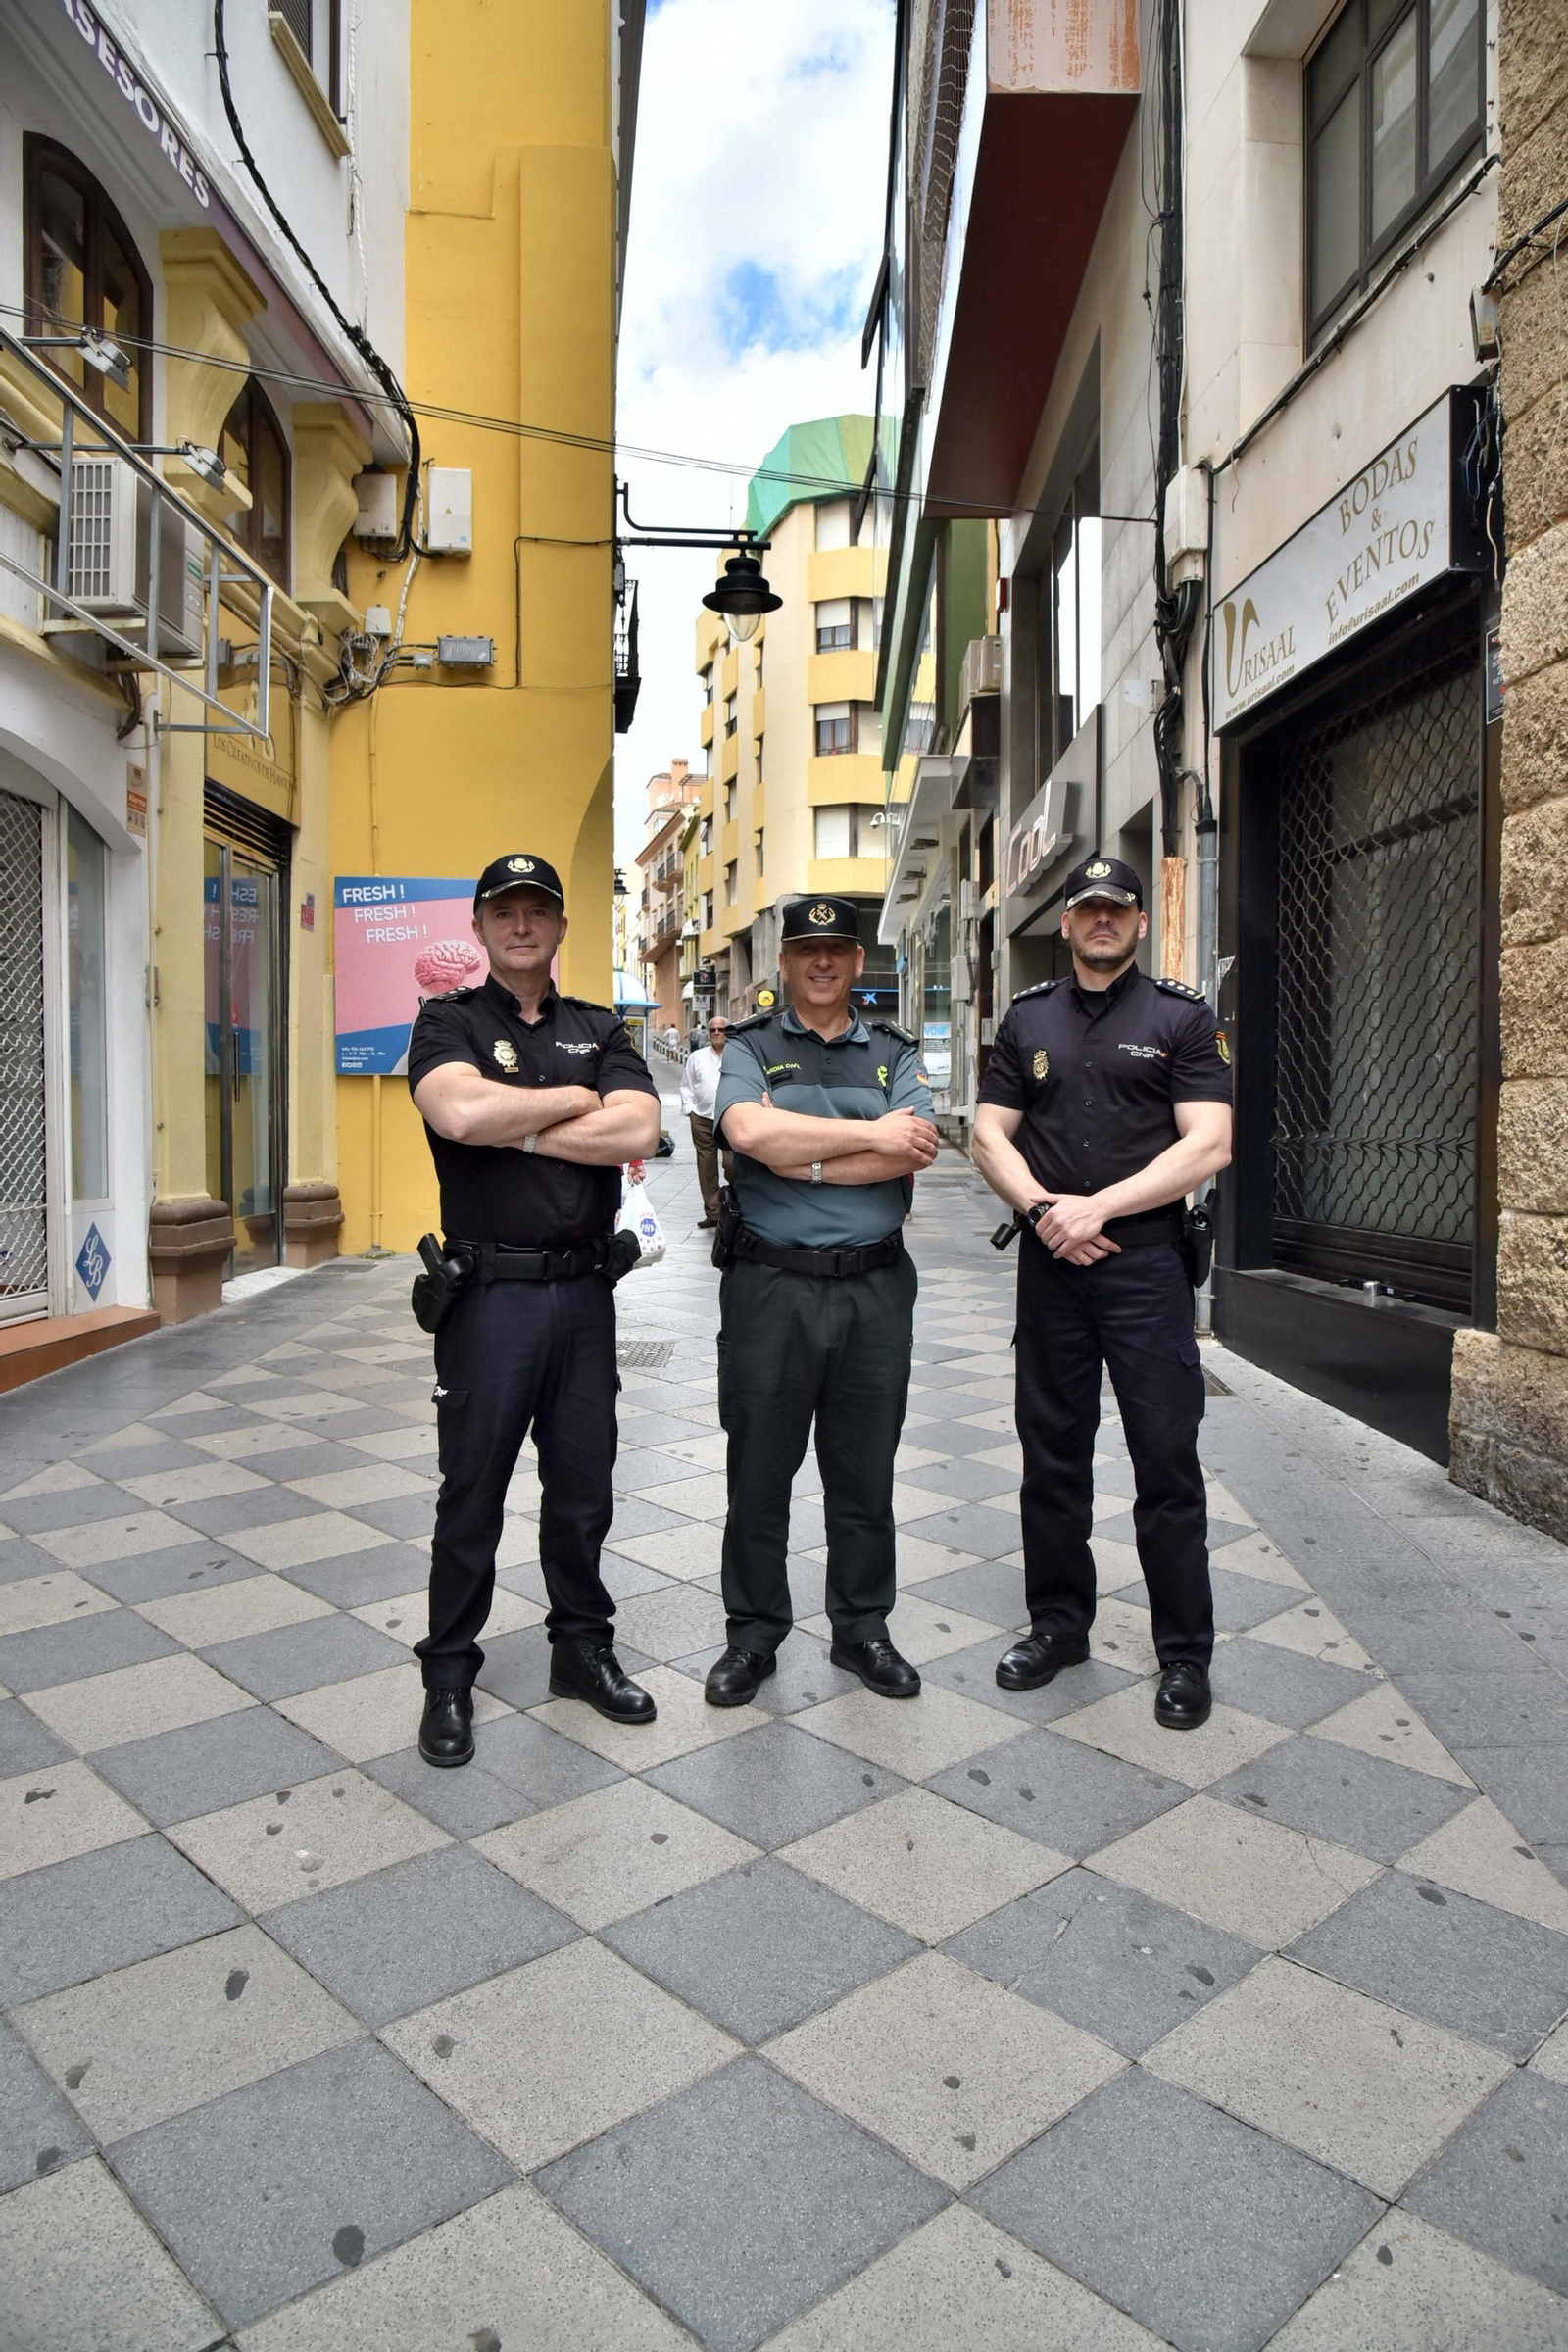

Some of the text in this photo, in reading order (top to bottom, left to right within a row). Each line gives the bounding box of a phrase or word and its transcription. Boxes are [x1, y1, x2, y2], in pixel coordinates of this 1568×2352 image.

[1338, 438, 1418, 536] BODAS
[1371, 507, 1382, 532] &
[1324, 518, 1436, 627] EVENTOS
[1328, 572, 1420, 646] info@urisaal.com
[1223, 598, 1297, 698] URISAAL
[1225, 664, 1295, 719] www.urisaal.com
[342, 883, 405, 904] FRESH !
[354, 904, 416, 923] FRESH !
[366, 924, 428, 944] FRESH !
[1118, 1043, 1163, 1056] POLICIA
